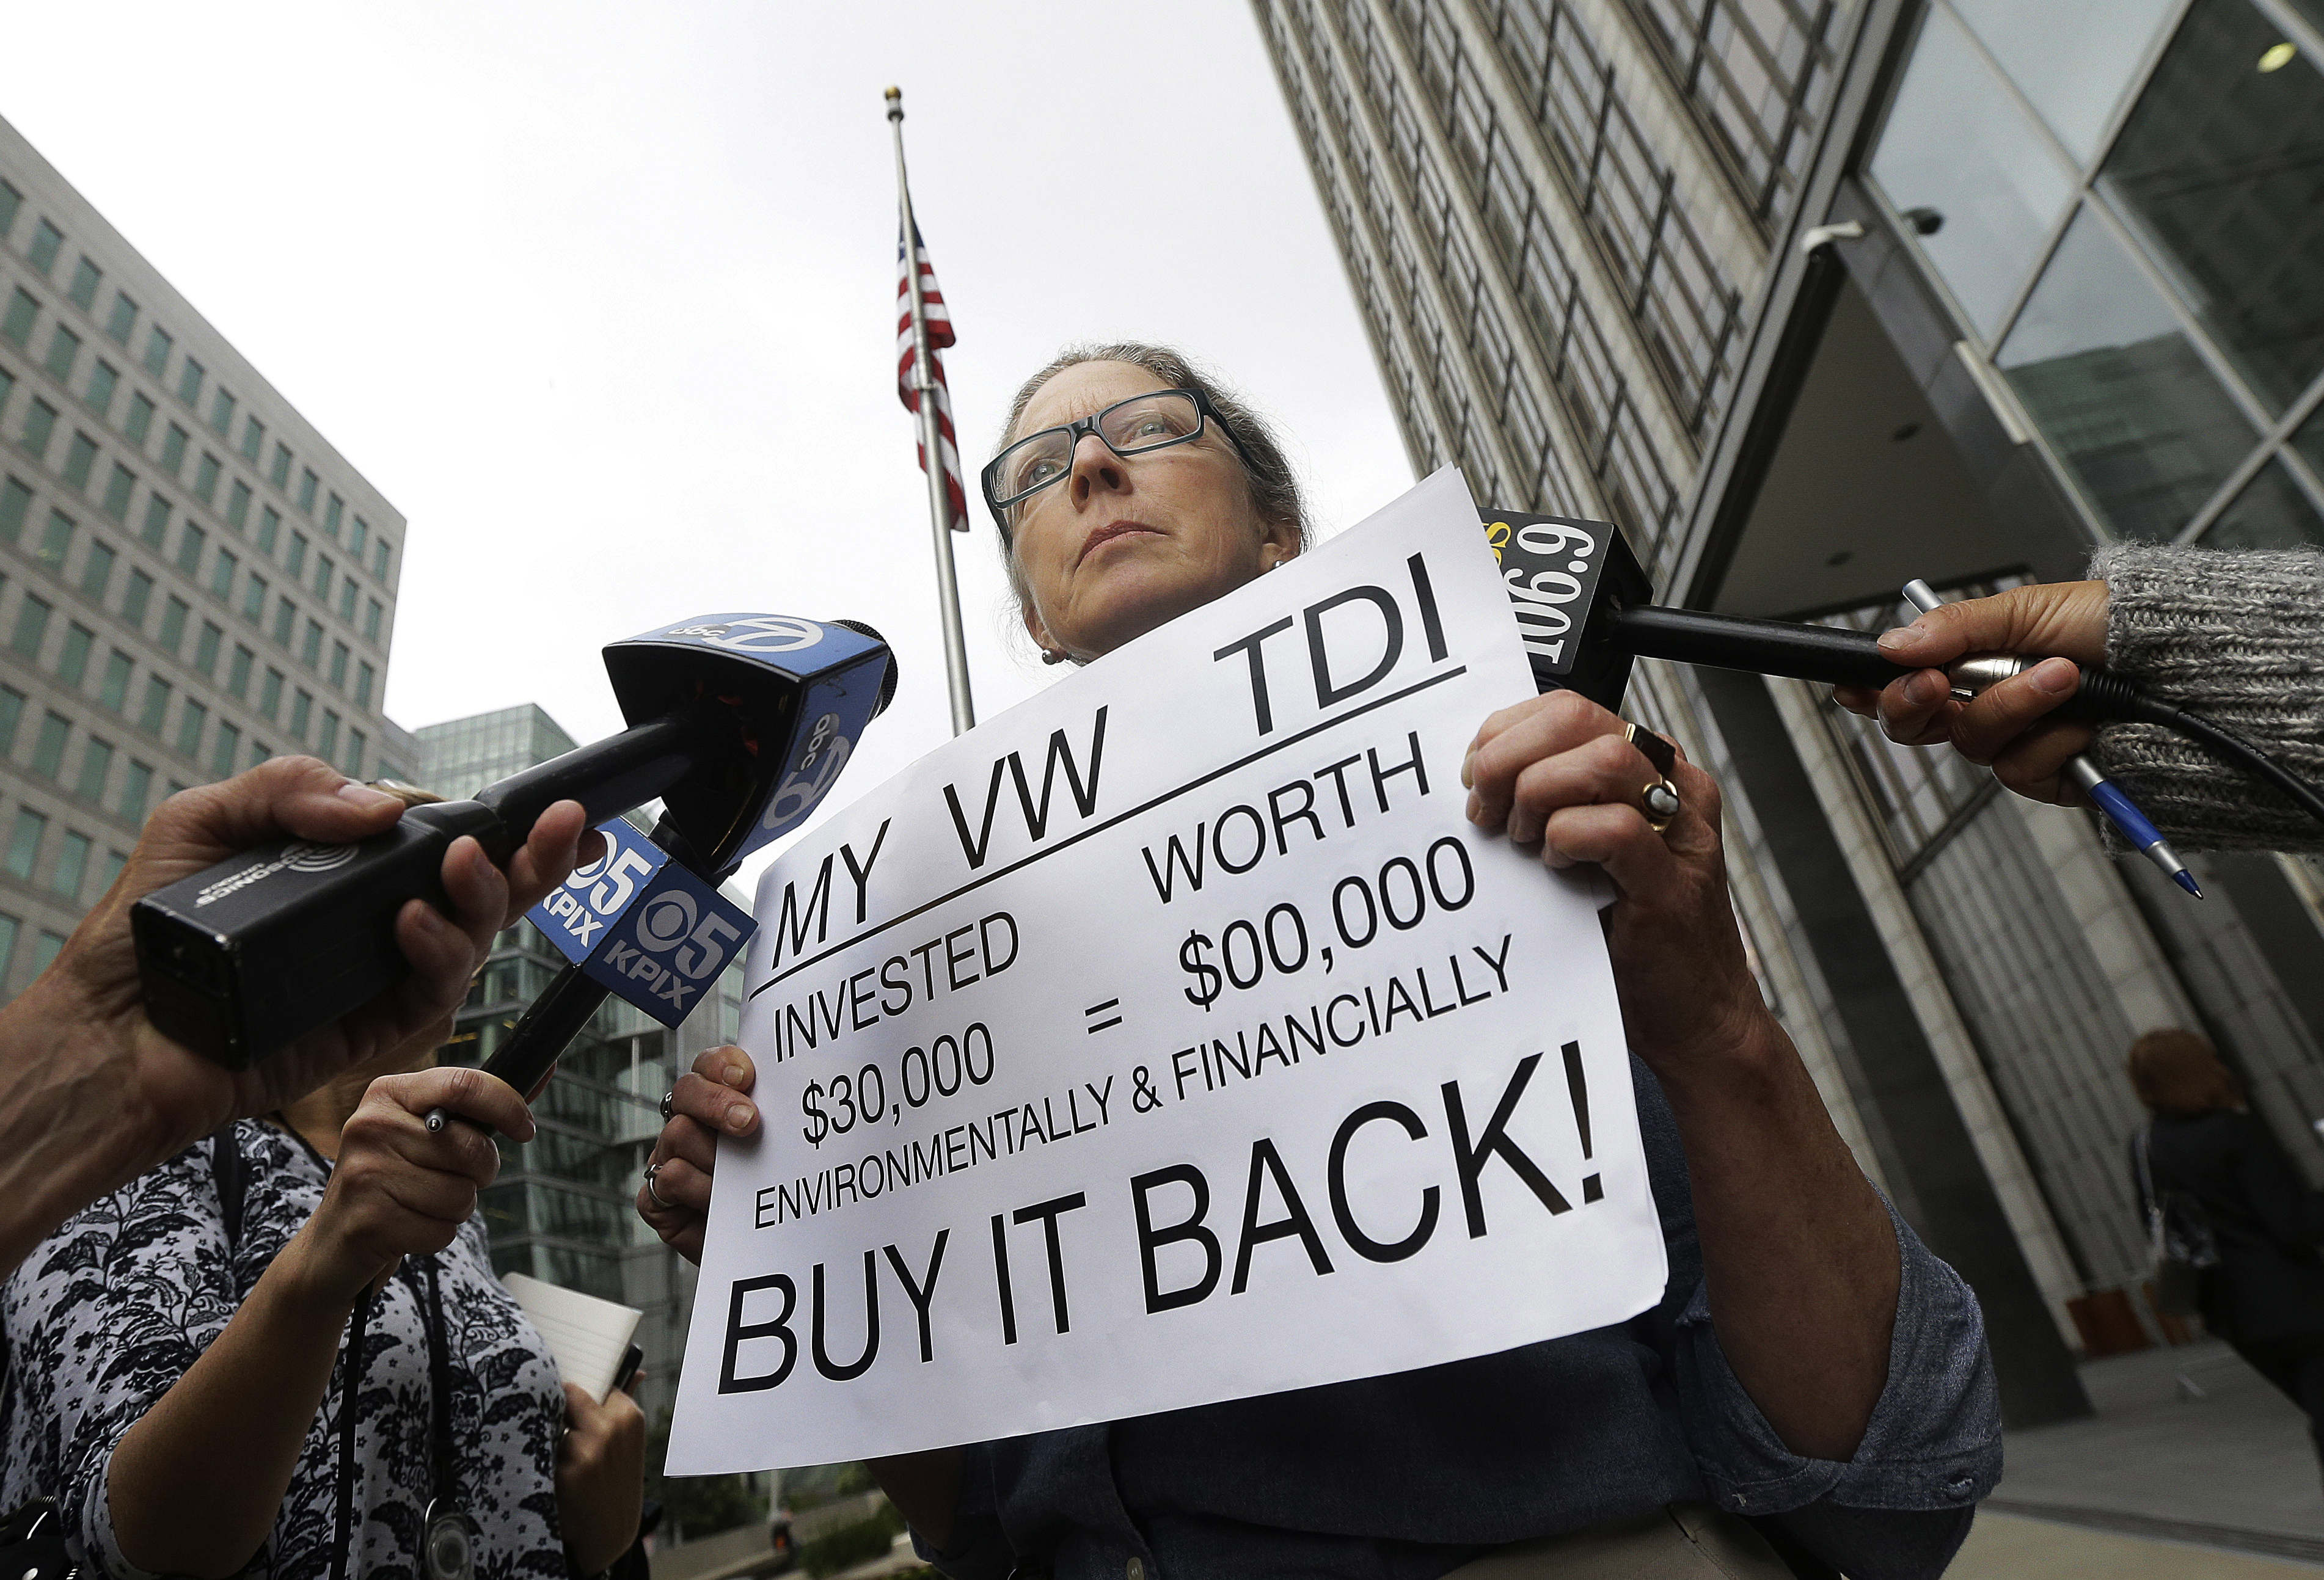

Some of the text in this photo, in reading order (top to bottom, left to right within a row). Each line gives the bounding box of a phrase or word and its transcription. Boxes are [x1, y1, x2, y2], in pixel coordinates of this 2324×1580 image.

[668, 627, 726, 637] abc
[799, 713, 831, 771] abc
[1503, 523, 1596, 664] 106.9
[771, 552, 1449, 970] MY VW TDI
[775, 730, 1430, 1063] INVESTED WORTH
[603, 939, 697, 1011] KPIX
[755, 933, 1512, 1230] ENVIRONMENTALLY & FINANCIALLY
[802, 836, 1475, 1150] $30,000 = $00,000
[717, 1039, 1604, 1395] BUY IT BACK!
